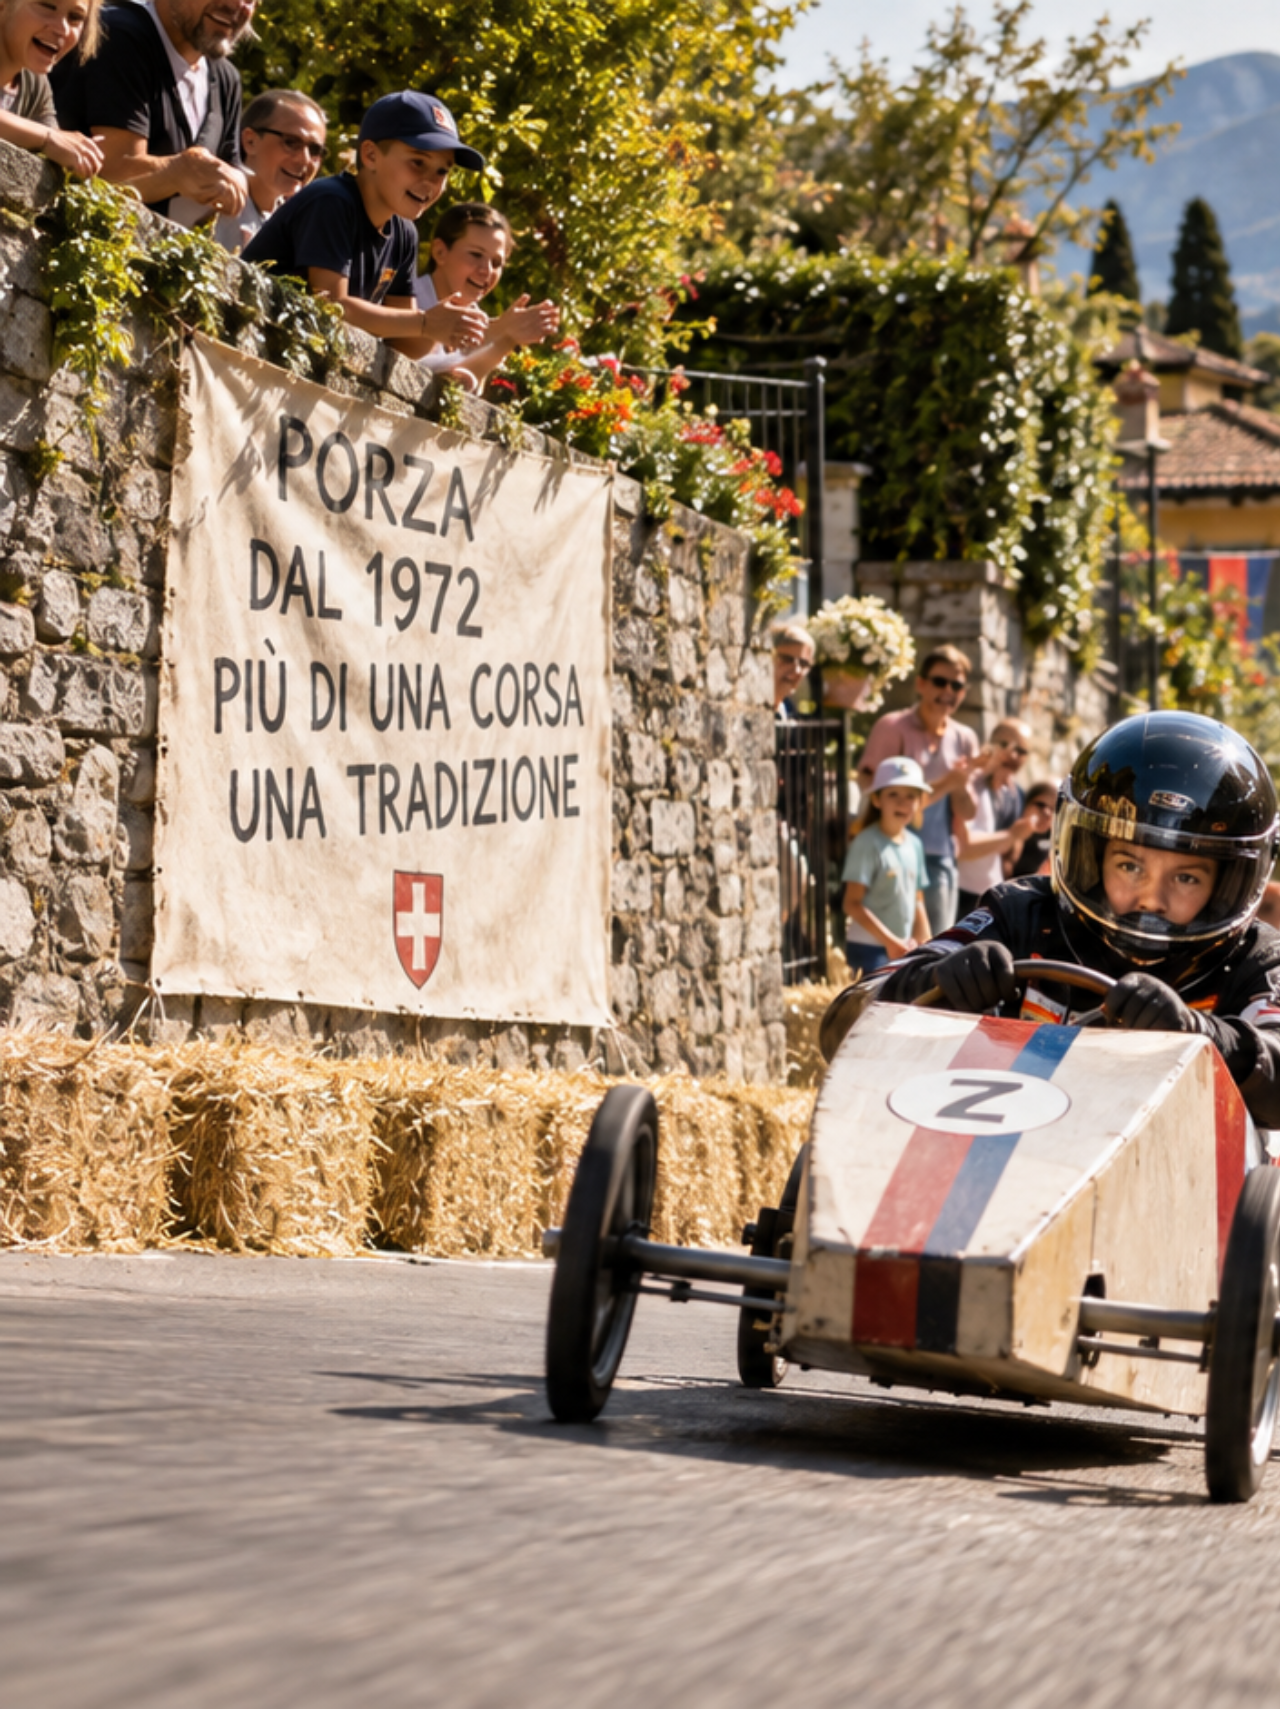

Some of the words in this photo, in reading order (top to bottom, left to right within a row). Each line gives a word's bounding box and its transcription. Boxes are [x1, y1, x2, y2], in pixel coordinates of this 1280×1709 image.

[276, 415, 474, 542] PORZA
[250, 538, 343, 621] DAL
[366, 551, 483, 639] 1972
[214, 638, 286, 735] PIÙ
[310, 660, 348, 732] DI
[369, 664, 451, 732] UNA
[470, 662, 584, 731] CORSA
[229, 767, 327, 843] UNA
[347, 754, 580, 836] TRADIZIONE
